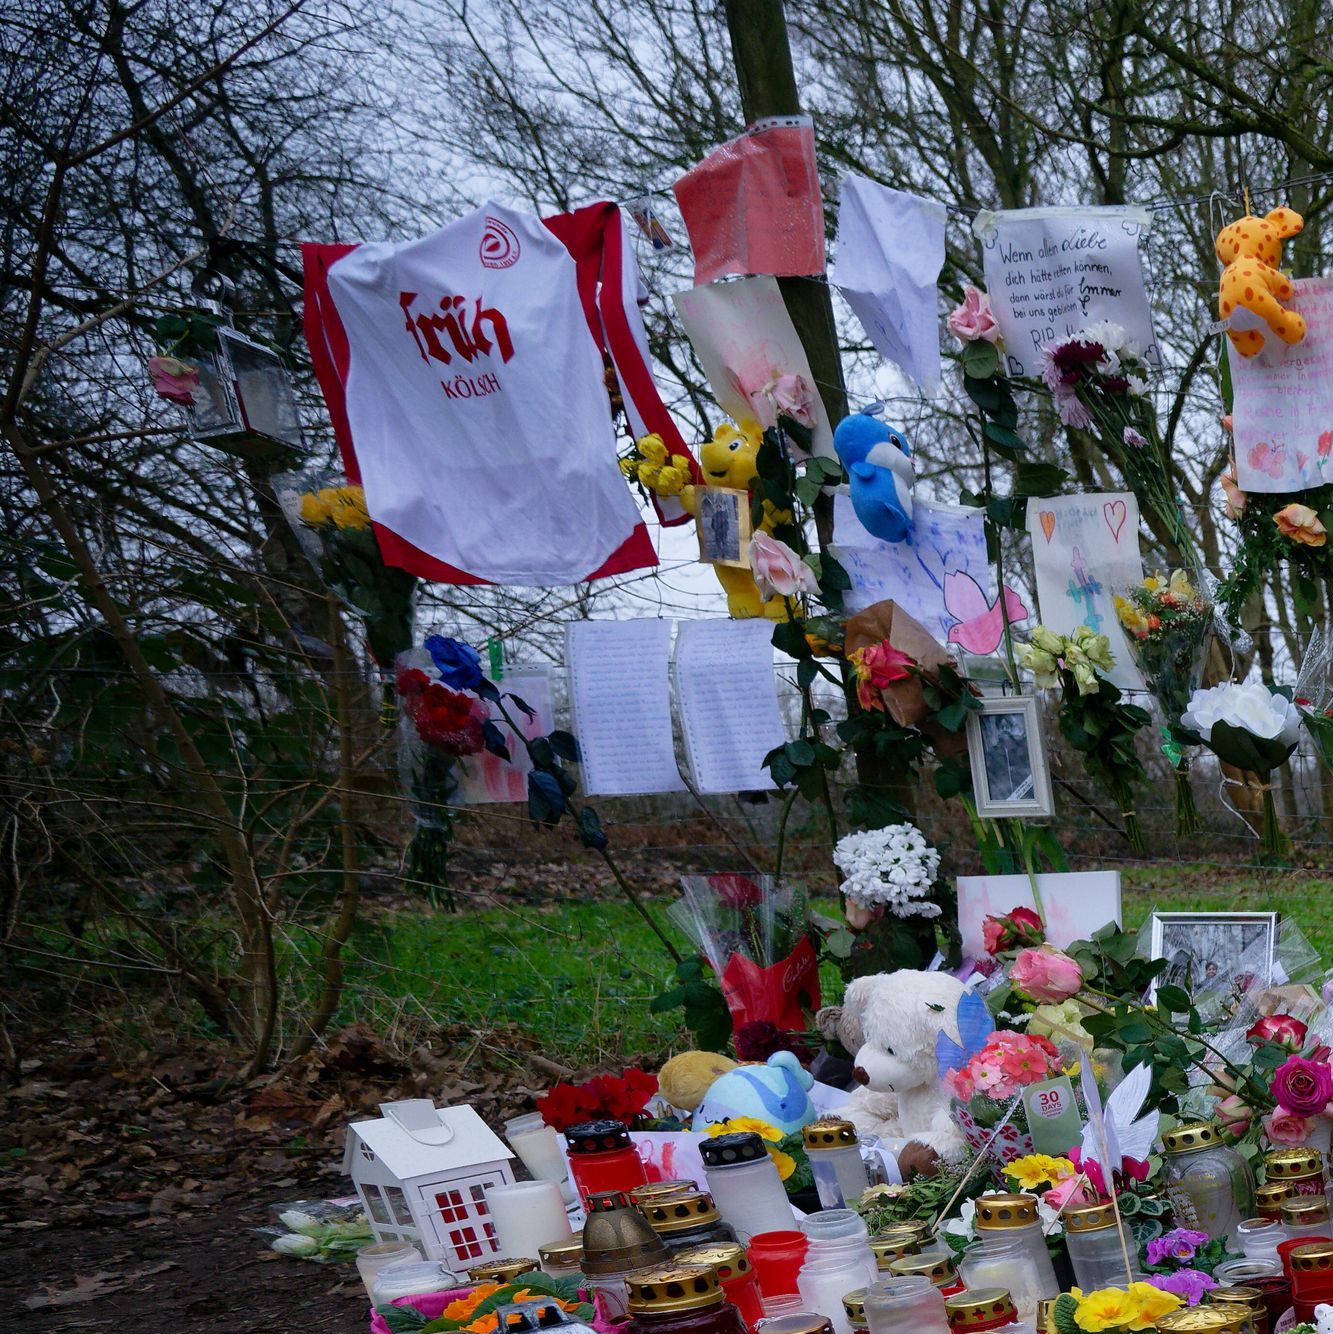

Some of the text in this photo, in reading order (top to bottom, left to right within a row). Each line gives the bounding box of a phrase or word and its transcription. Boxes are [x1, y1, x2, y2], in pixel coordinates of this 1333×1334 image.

[1000, 243, 1033, 264] Wenn
[1062, 226, 1107, 252] Liebe
[1005, 271, 1026, 286] dich
[1010, 291, 1030, 304] dann
[1013, 306, 1026, 319] bei
[1029, 307, 1045, 317] uns
[441, 373, 501, 399] KÖLSCH
[1039, 1090, 1059, 1106] 30
[1042, 1102, 1062, 1112] DAYS
